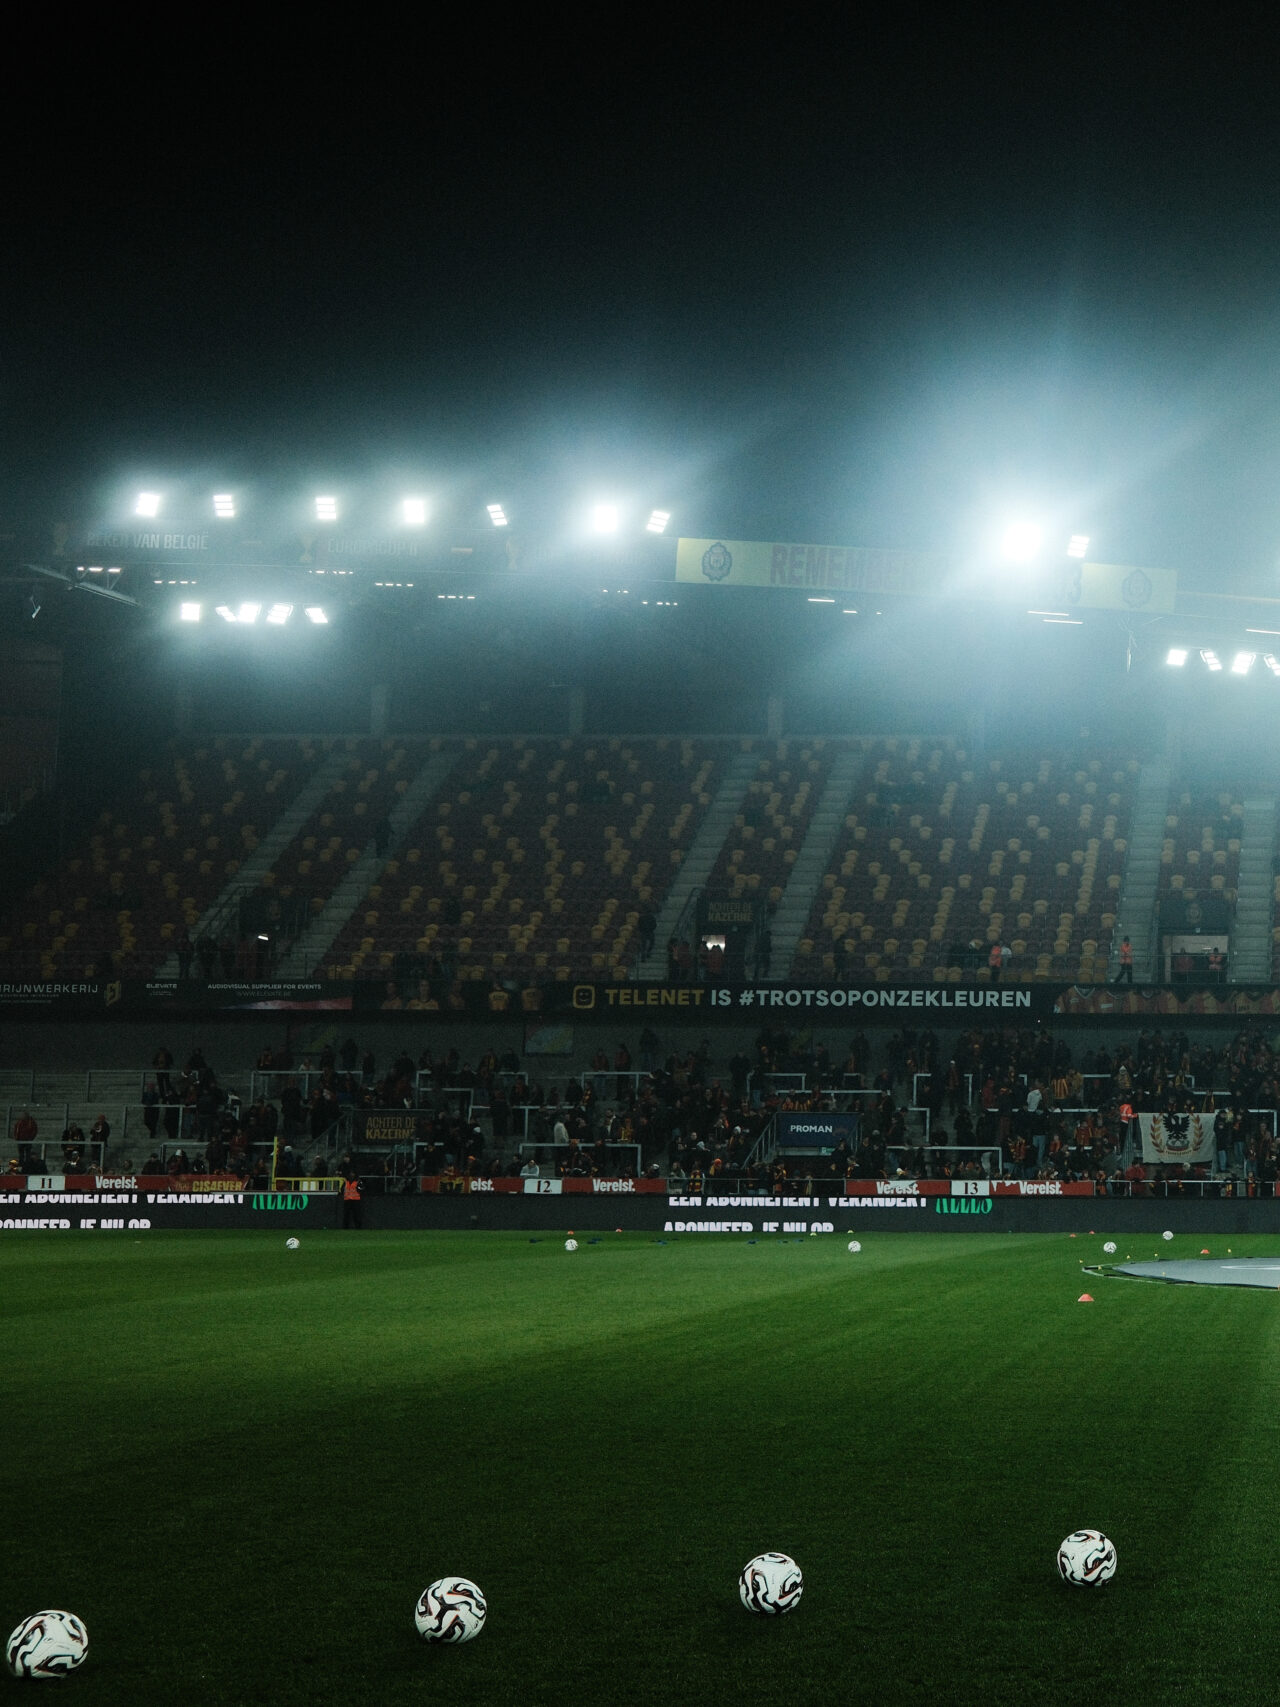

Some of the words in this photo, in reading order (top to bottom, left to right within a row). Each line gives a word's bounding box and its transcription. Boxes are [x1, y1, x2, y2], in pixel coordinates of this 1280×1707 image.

[133, 534, 160, 548] VAN
[164, 531, 209, 550] BELGIË
[605, 988, 706, 1006] TELENET
[711, 989, 733, 1007] IS
[739, 989, 1032, 1008] #TROTSOPONZEKLEUREN
[366, 1117, 402, 1129] ACHTER
[790, 1125, 833, 1133] PROMAN
[95, 1175, 138, 1189] Verelst.
[471, 1178, 495, 1191] elst.
[537, 1180, 551, 1193] 12
[592, 1178, 636, 1193] Verelst.
[964, 1182, 978, 1195] 13
[1019, 1181, 1063, 1195] Verelst.
